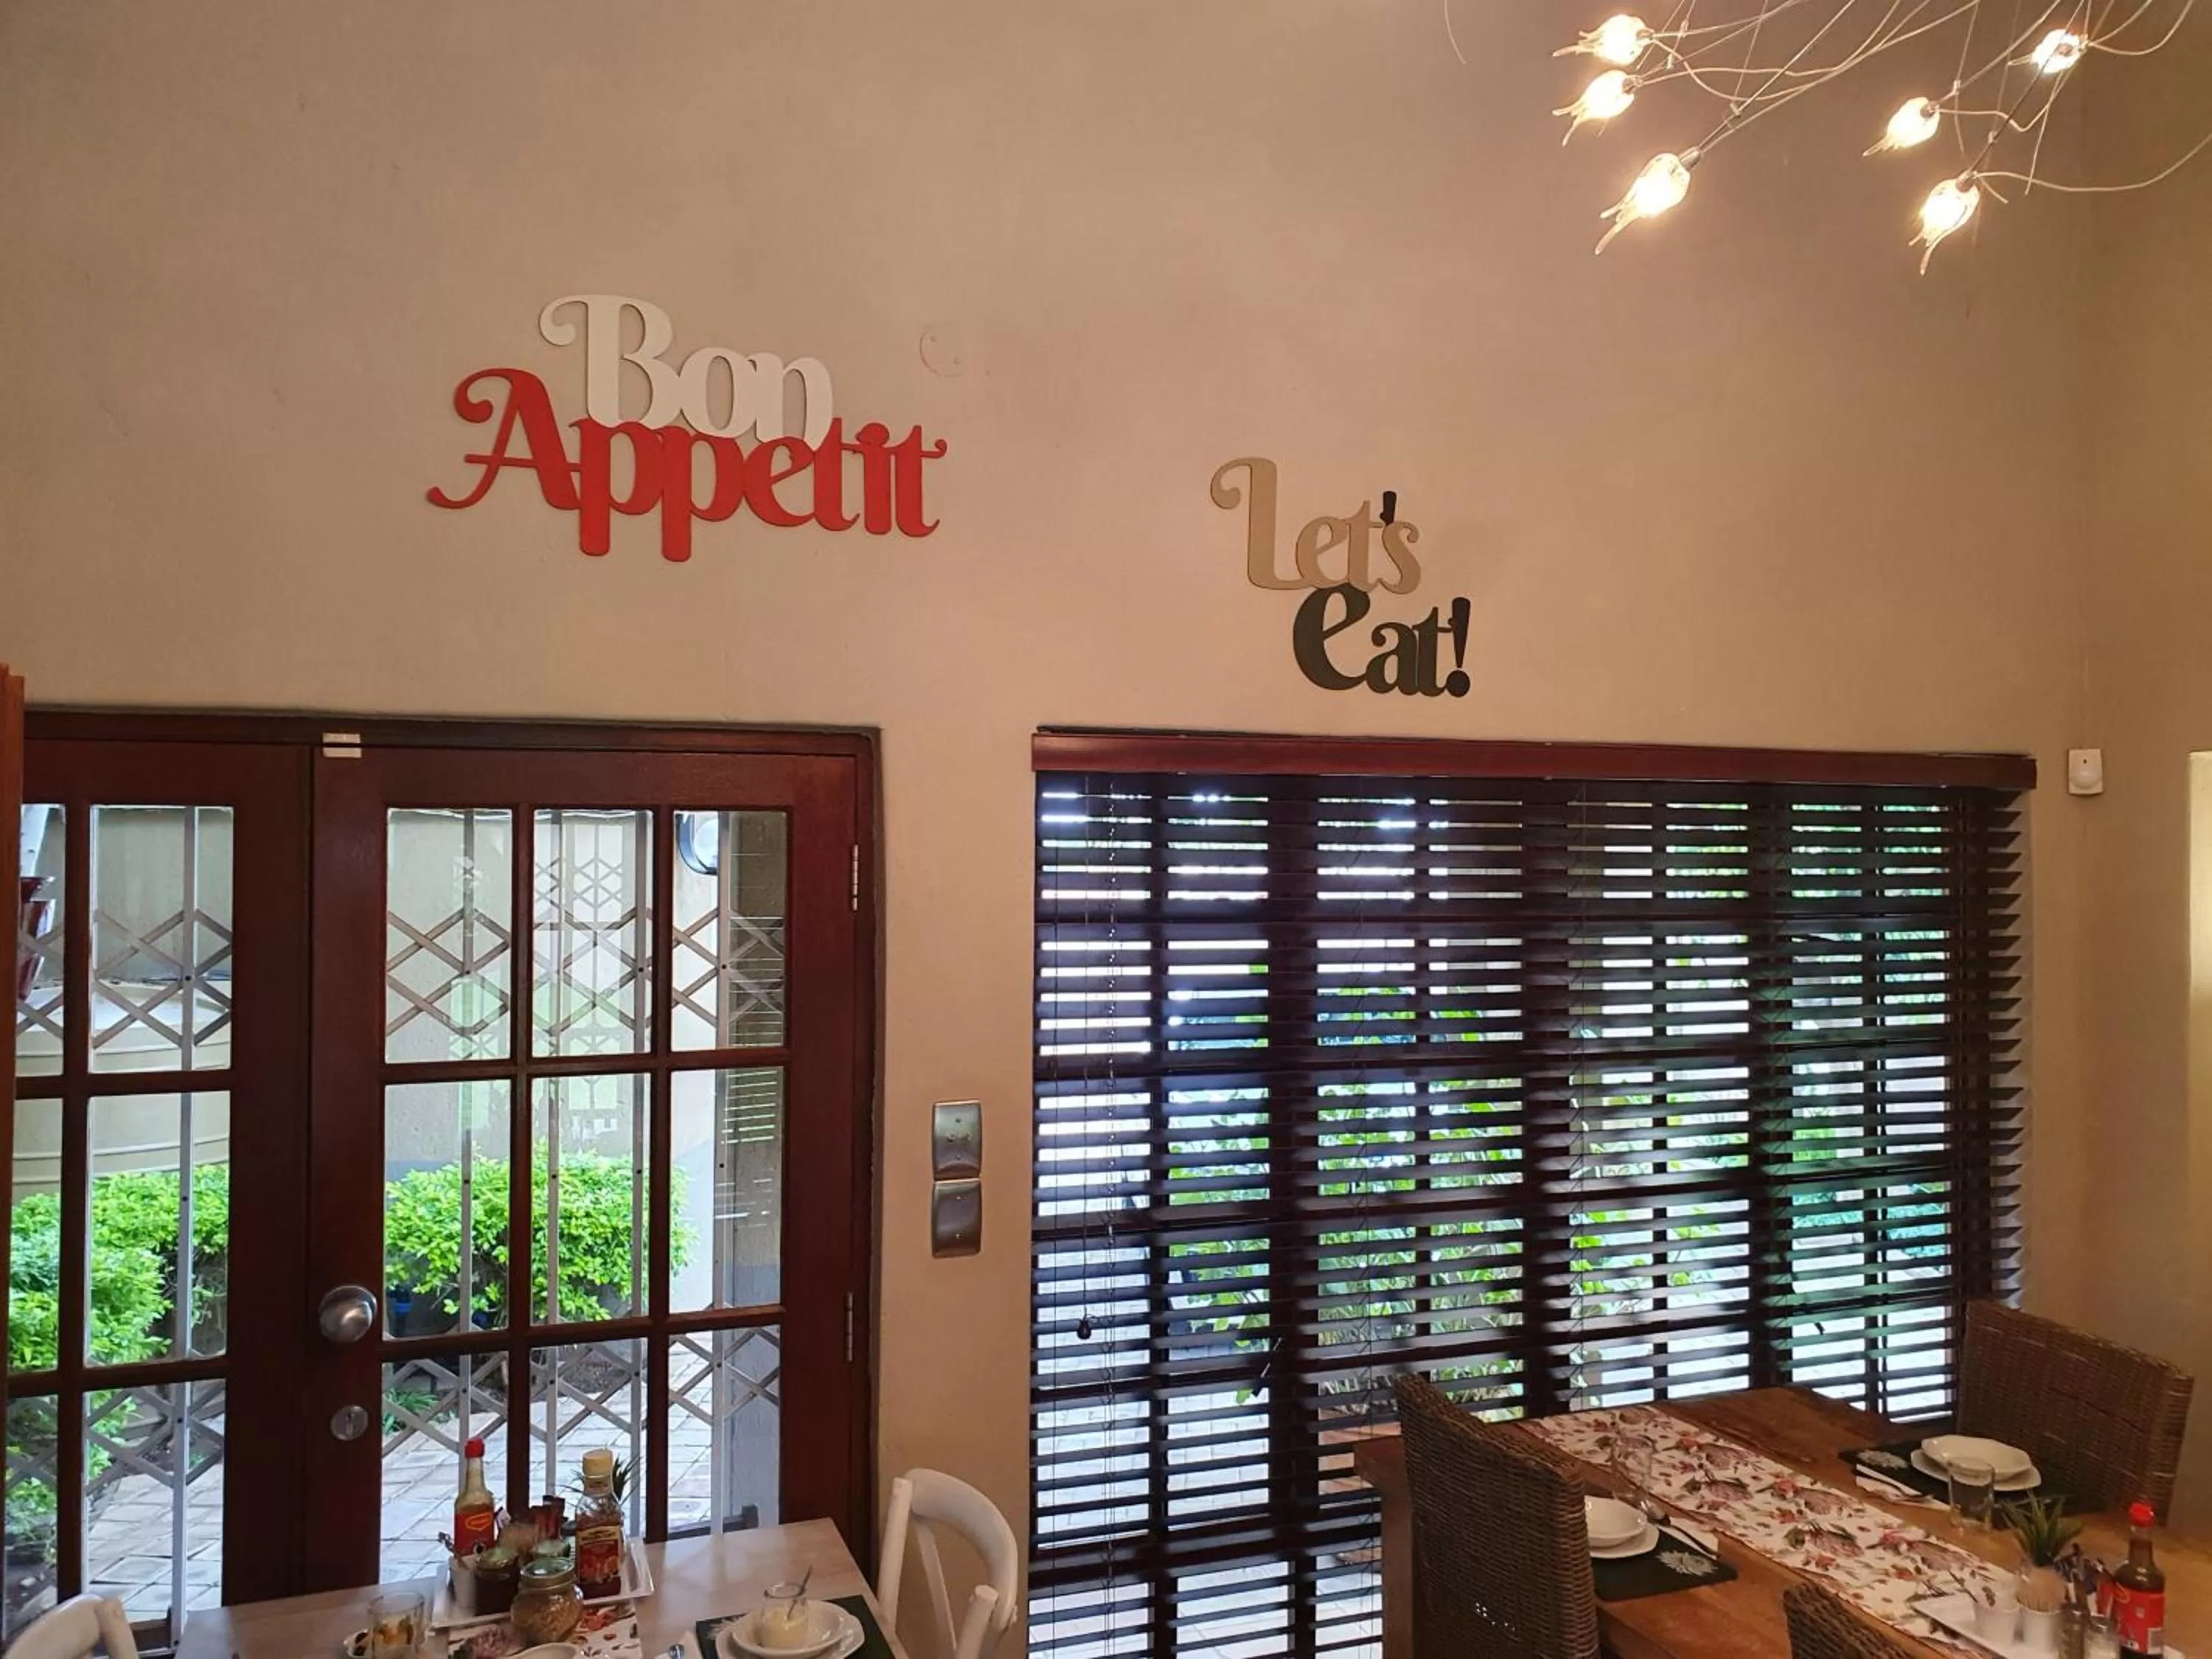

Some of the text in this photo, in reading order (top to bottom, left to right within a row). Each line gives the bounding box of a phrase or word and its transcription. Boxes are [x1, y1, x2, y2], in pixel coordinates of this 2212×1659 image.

[538, 294, 833, 451] Bon
[425, 368, 947, 563] Appetit
[1210, 457, 1422, 594] Let's
